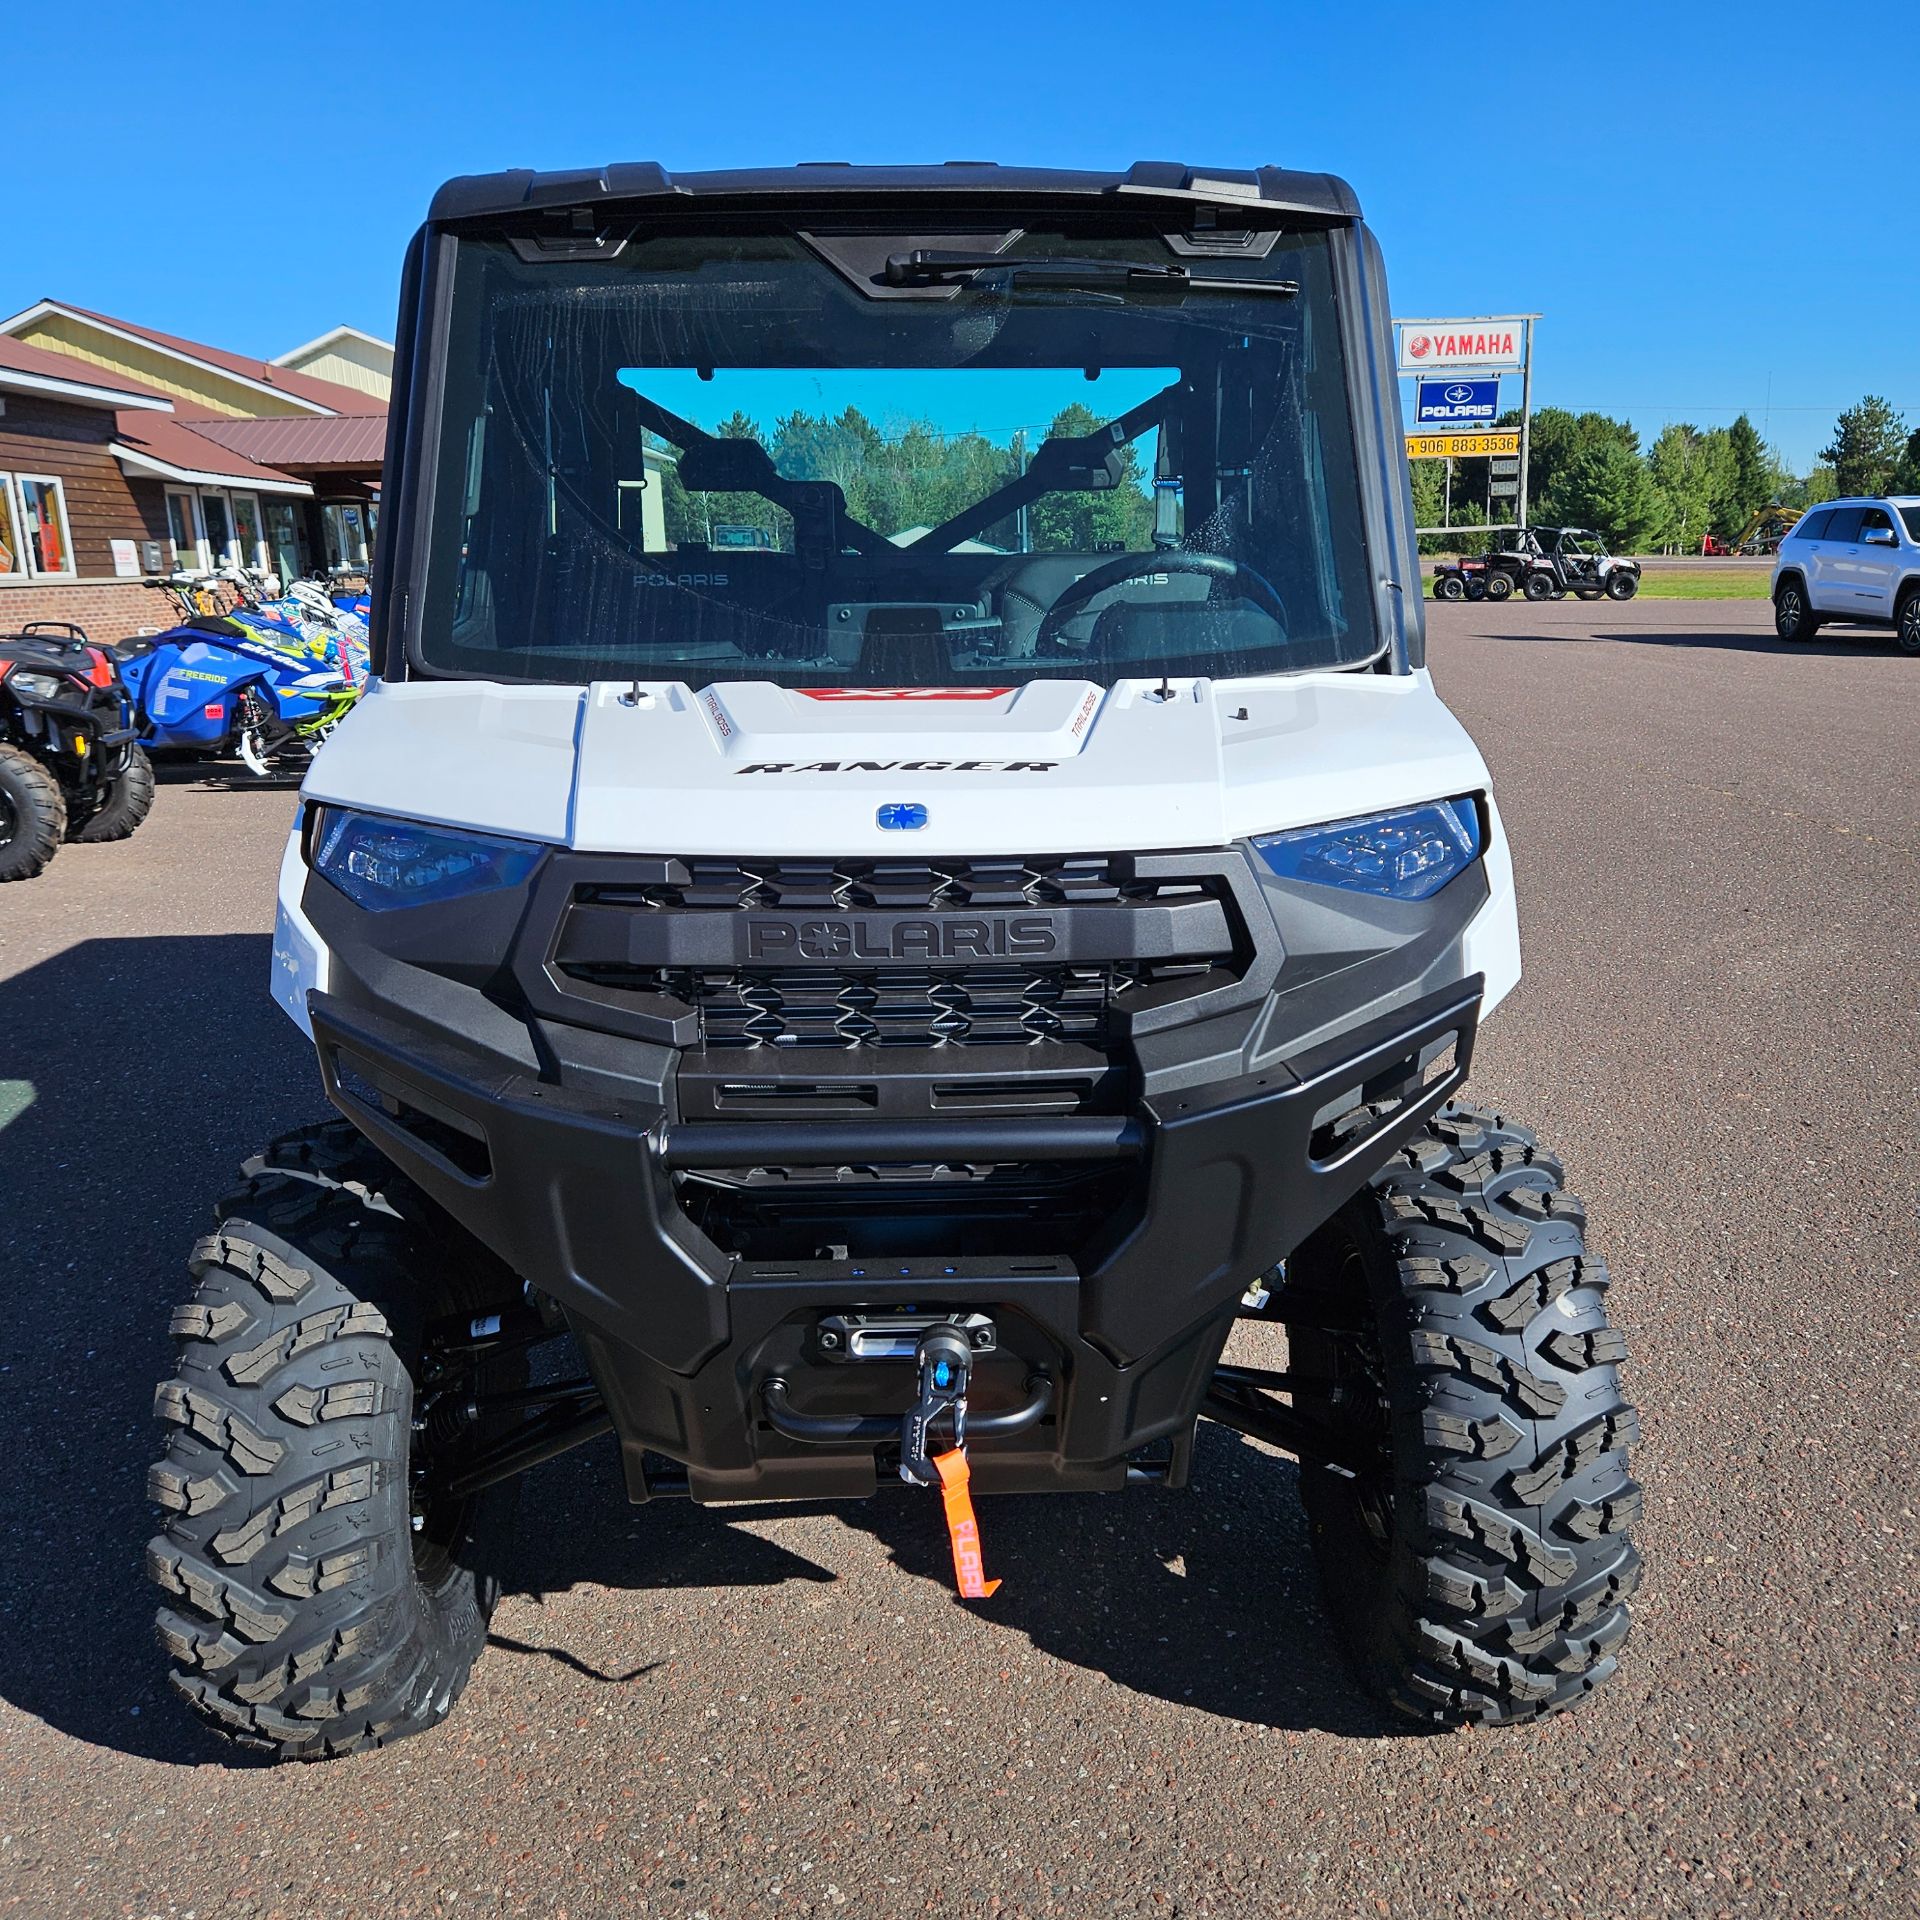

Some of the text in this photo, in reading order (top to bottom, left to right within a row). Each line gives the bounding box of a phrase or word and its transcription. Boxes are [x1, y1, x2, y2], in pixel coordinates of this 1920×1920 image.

[1433, 333, 1514, 356] YAMAHA
[1421, 404, 1494, 418] POLARIS
[1451, 437, 1515, 453] 883-3536
[633, 574, 729, 587] POLARIS
[179, 669, 228, 685] FREERIDE
[733, 760, 1060, 774] RANGER
[748, 917, 1057, 959] POLARIS
